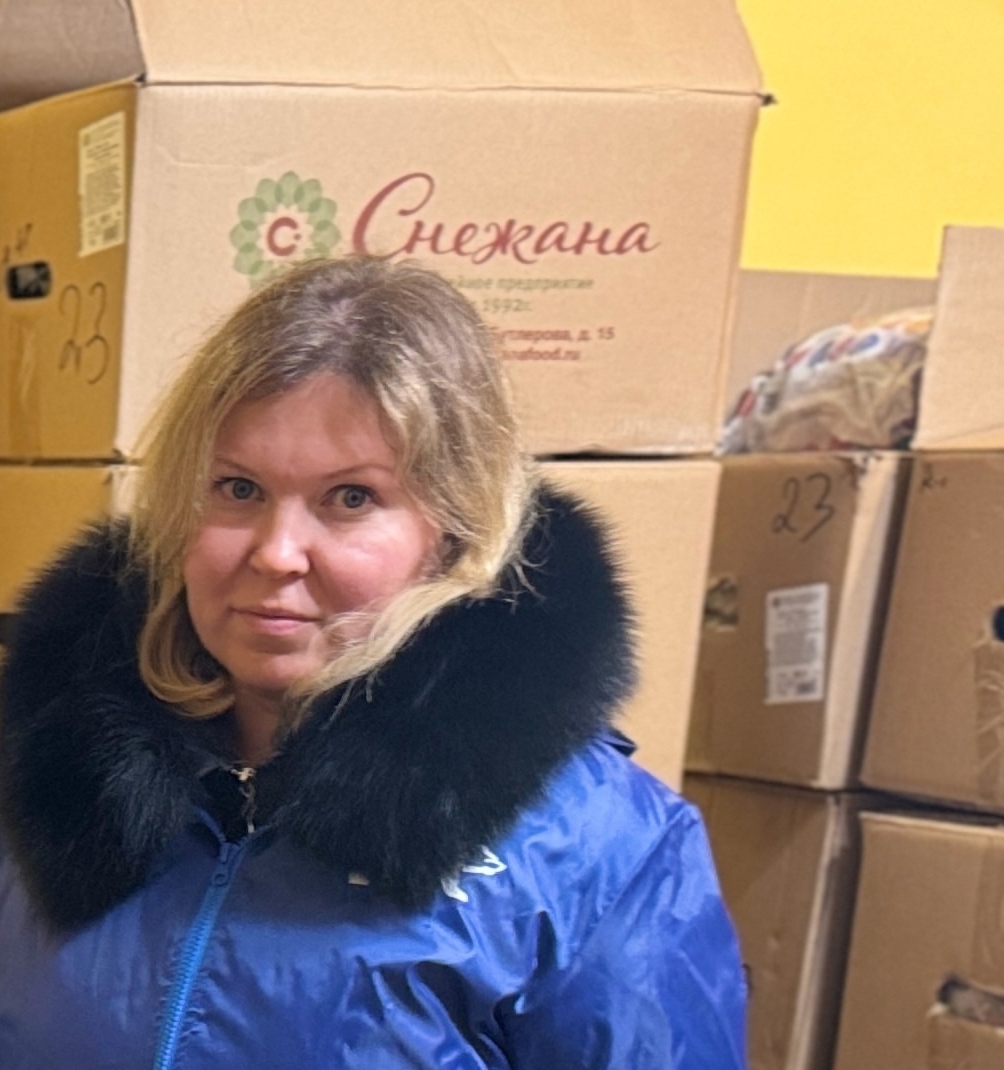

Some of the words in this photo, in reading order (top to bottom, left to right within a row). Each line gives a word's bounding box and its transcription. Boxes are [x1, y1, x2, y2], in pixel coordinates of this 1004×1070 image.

[351, 172, 662, 265] Снежана
[498, 278, 595, 293] предприятие
[597, 326, 615, 340] 15
[771, 471, 836, 543] 23
